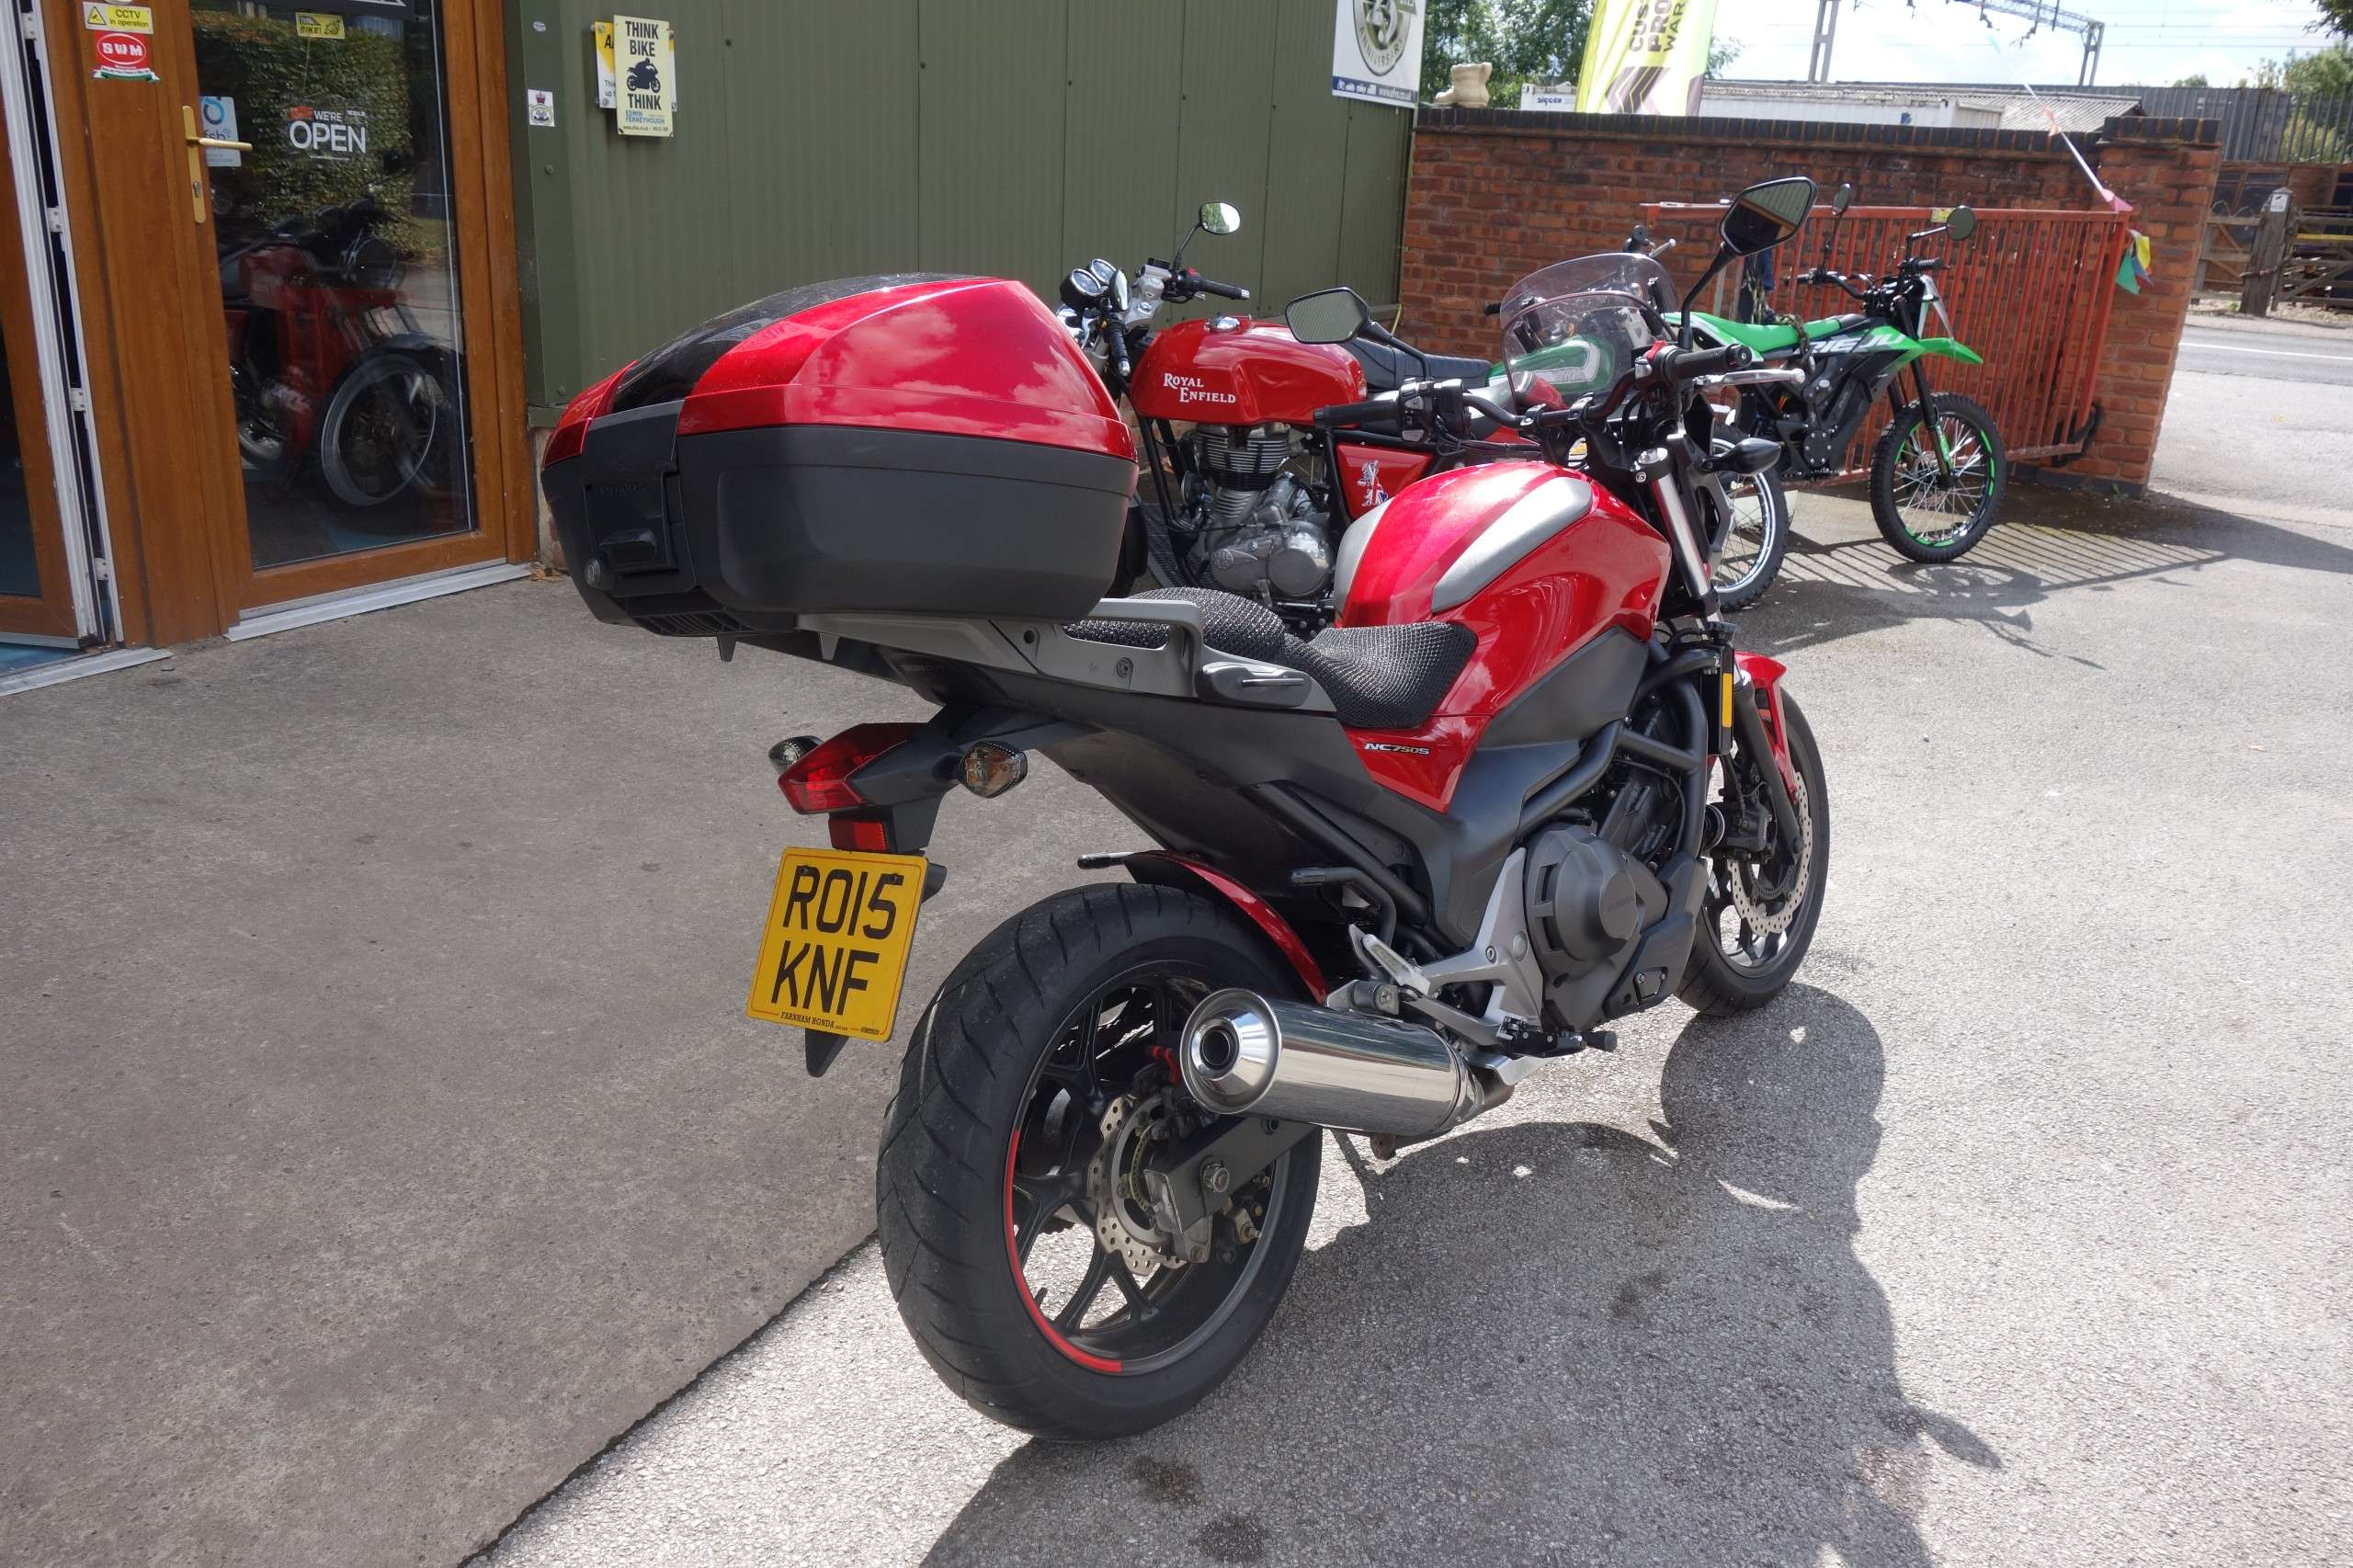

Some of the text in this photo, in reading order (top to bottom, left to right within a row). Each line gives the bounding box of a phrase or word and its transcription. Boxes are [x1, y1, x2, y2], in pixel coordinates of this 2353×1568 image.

[116, 9, 141, 19] CCTV
[118, 19, 149, 28] operation
[624, 20, 659, 40] THINK
[1629, 0, 1649, 52] CUS
[102, 42, 142, 56] SWM
[630, 40, 655, 57] BIKE
[627, 93, 662, 110] THINK
[313, 110, 343, 122] WE'RE
[290, 120, 367, 153] OPEN
[1163, 372, 1204, 389] ROYAL
[1179, 387, 1236, 403] ENFIELD
[1364, 743, 1430, 755] NC750S
[783, 864, 905, 940] RO15
[770, 939, 880, 1016] KNF
[780, 1011, 812, 1024] FARNHAM
[812, 1017, 835, 1028] HONDA
